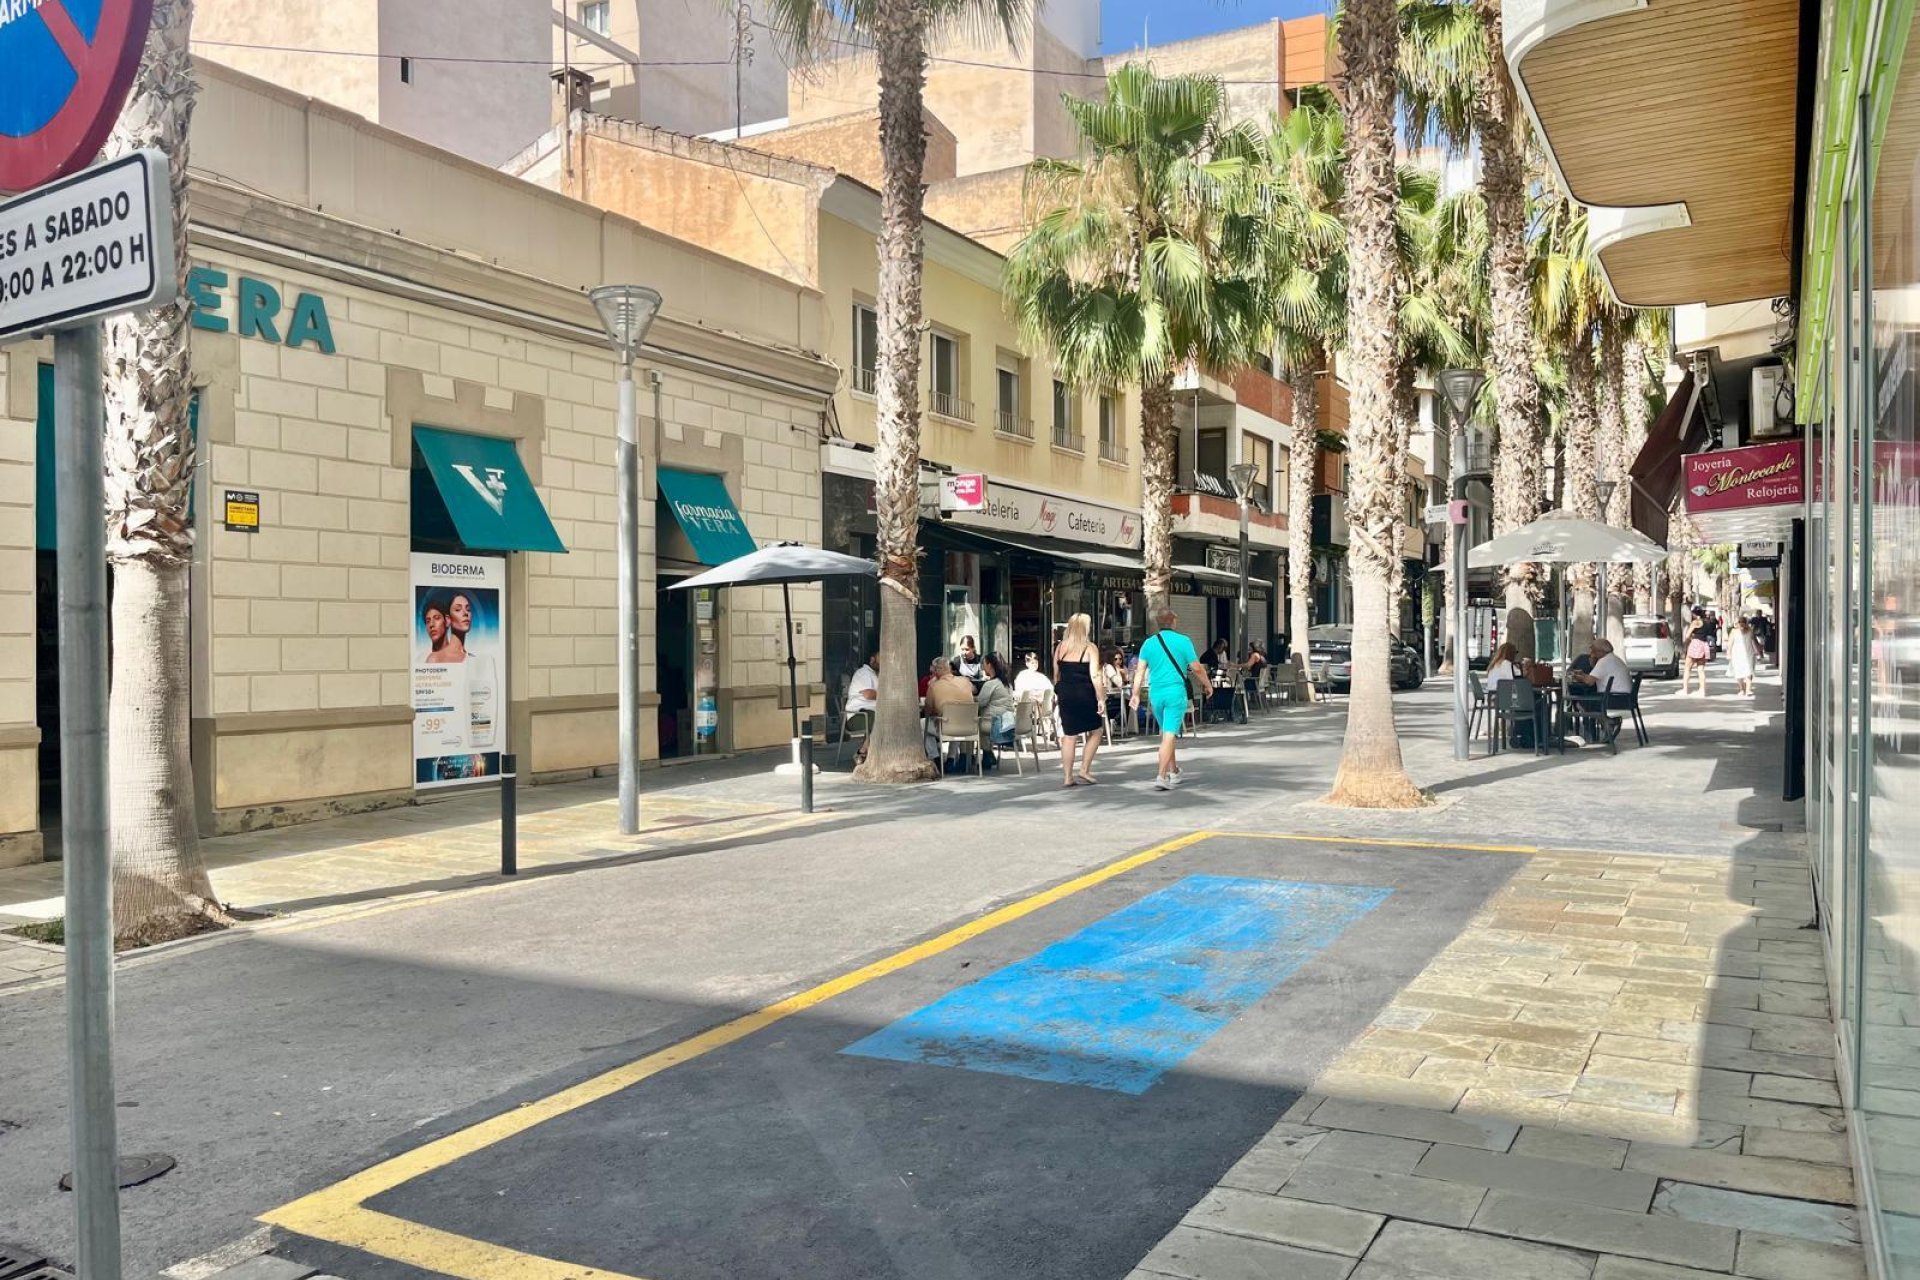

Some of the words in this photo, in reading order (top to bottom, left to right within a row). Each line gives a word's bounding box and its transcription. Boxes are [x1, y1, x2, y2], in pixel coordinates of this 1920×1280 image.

[24, 223, 37, 251] A
[45, 191, 130, 243] SABADO
[41, 261, 54, 291] A
[62, 240, 122, 284] 22:00
[129, 233, 145, 264] H
[1692, 457, 1733, 473] Joyería
[1705, 452, 1796, 496] Montecarlo
[1746, 484, 1799, 499] Relojería
[689, 516, 741, 535] VERA
[431, 562, 485, 576] BIODERMA
